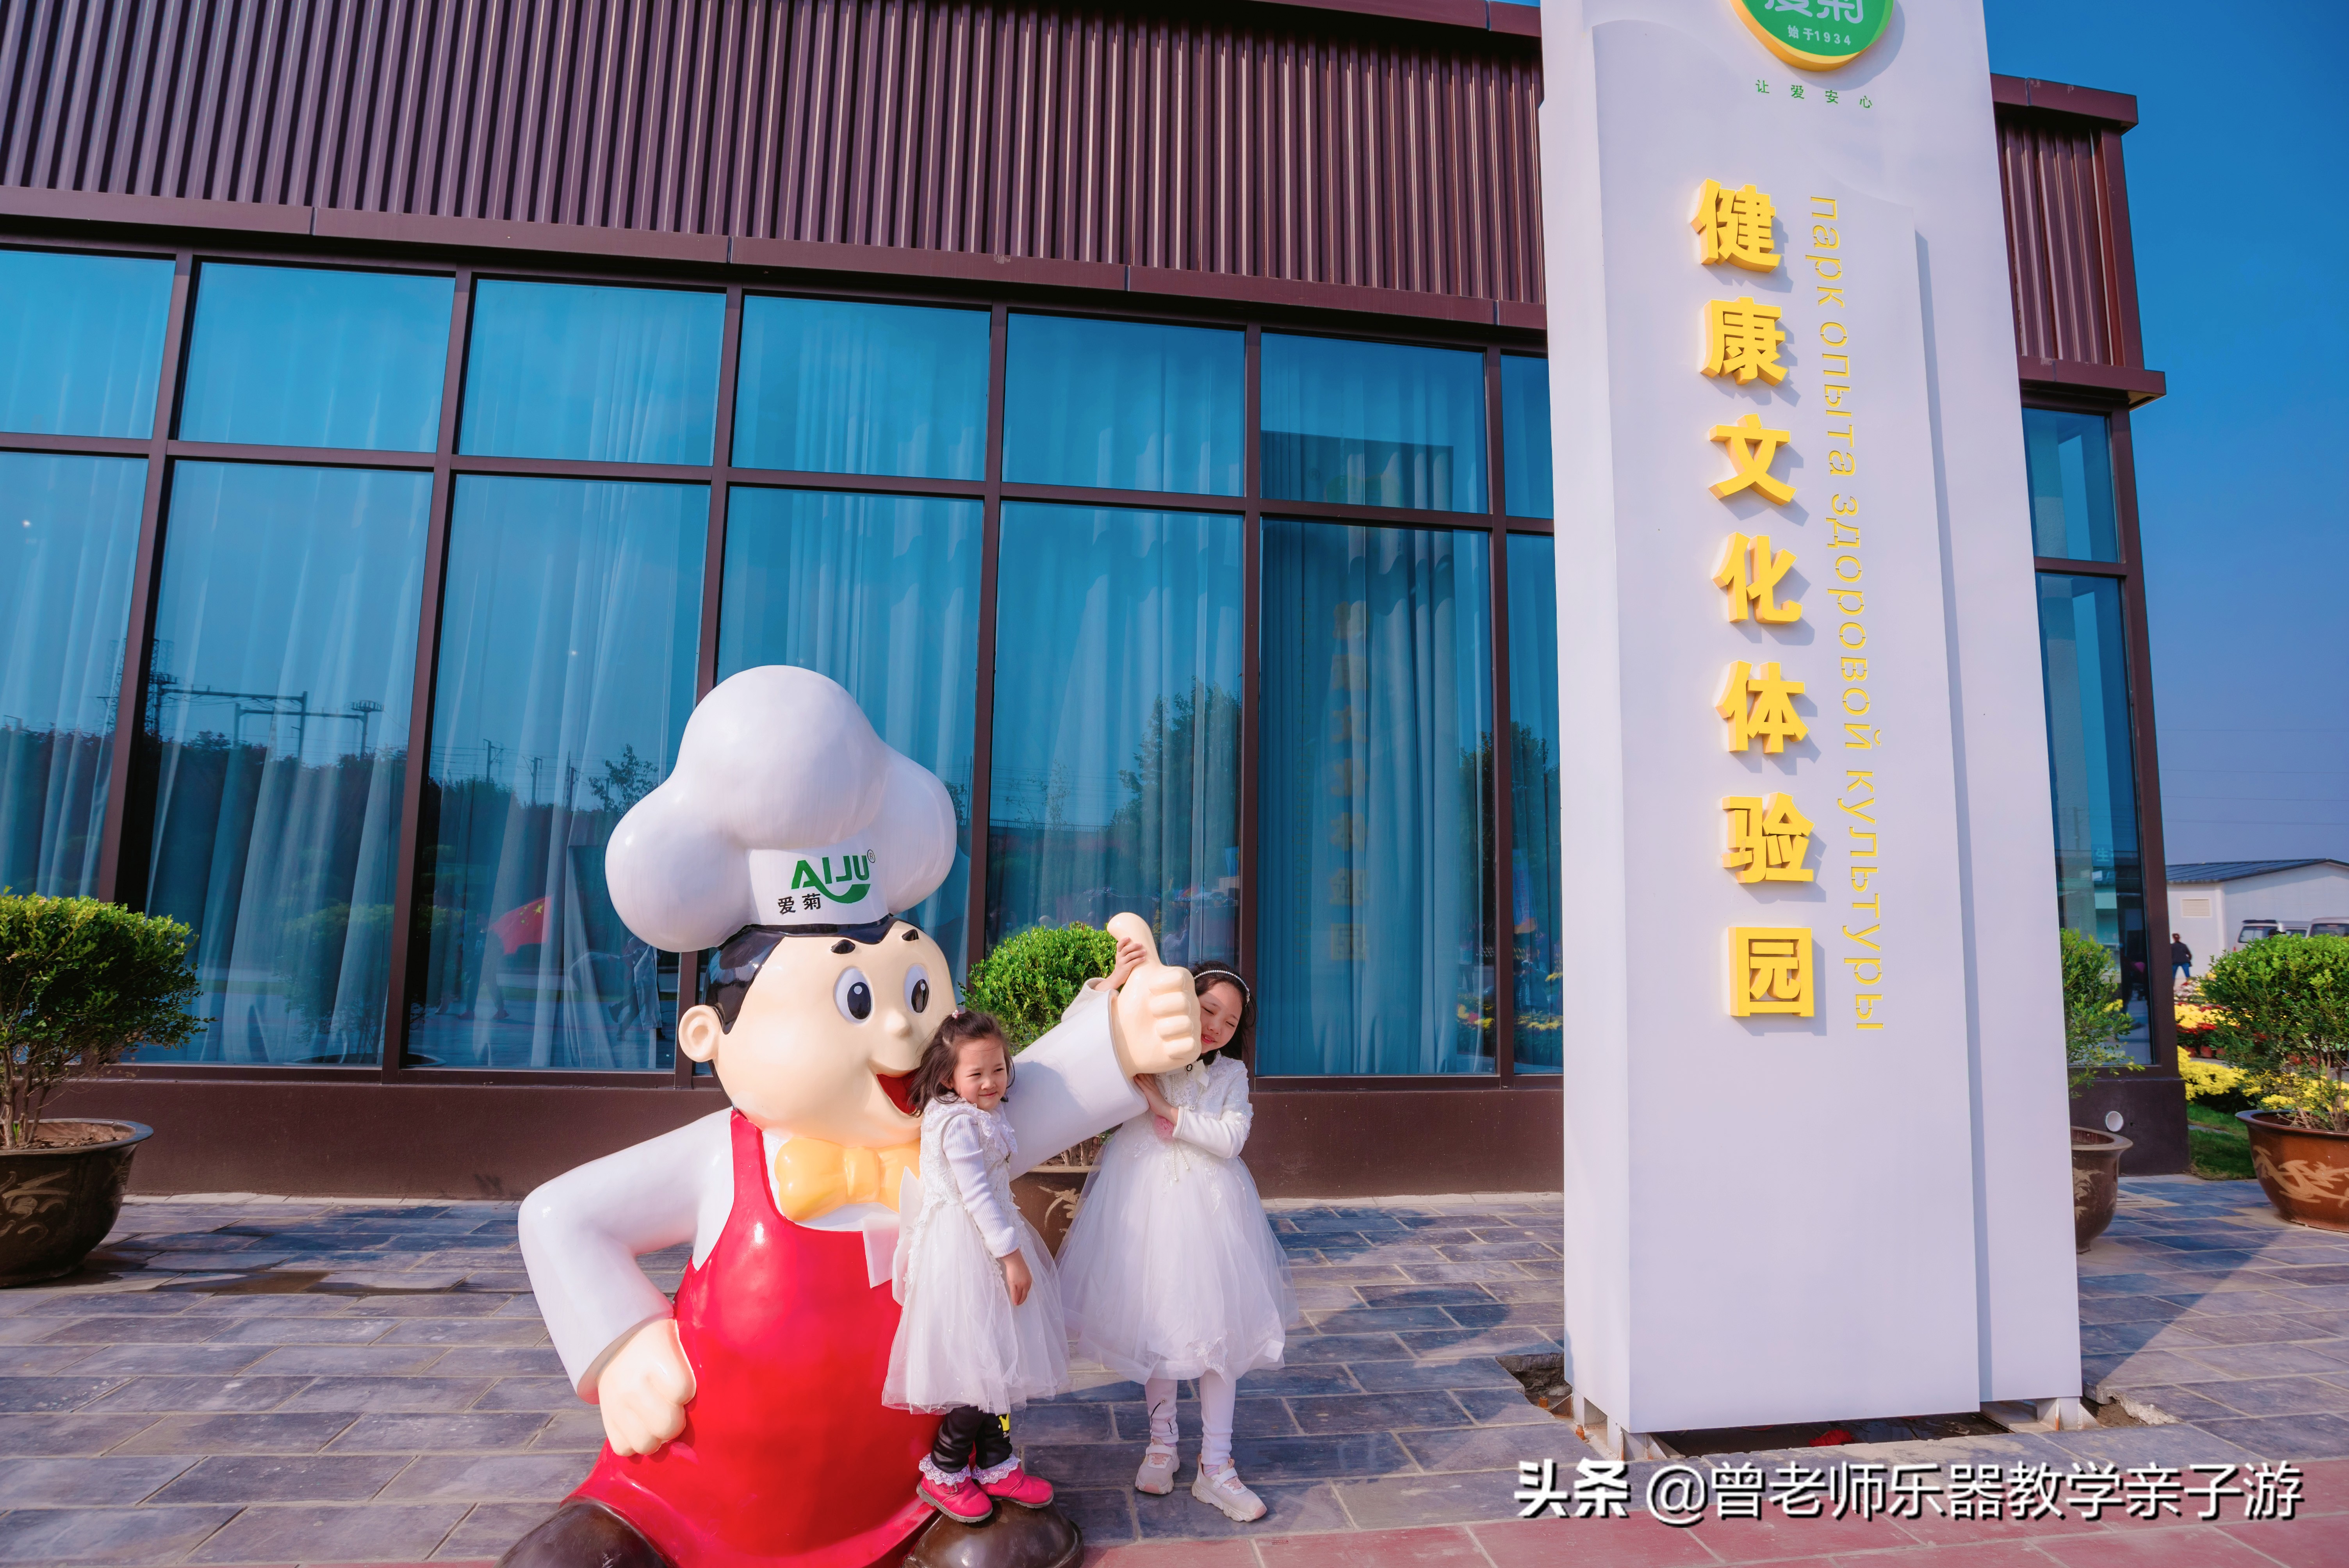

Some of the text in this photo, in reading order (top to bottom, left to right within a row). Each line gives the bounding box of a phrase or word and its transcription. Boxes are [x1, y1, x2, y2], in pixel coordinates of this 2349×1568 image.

[1755, 79, 1873, 109] 让爱安心
[1690, 178, 1815, 1017] 健康文化体验园
[1805, 195, 1884, 1030] парк опыта здоровой культуры
[777, 893, 821, 915] 爱菊
